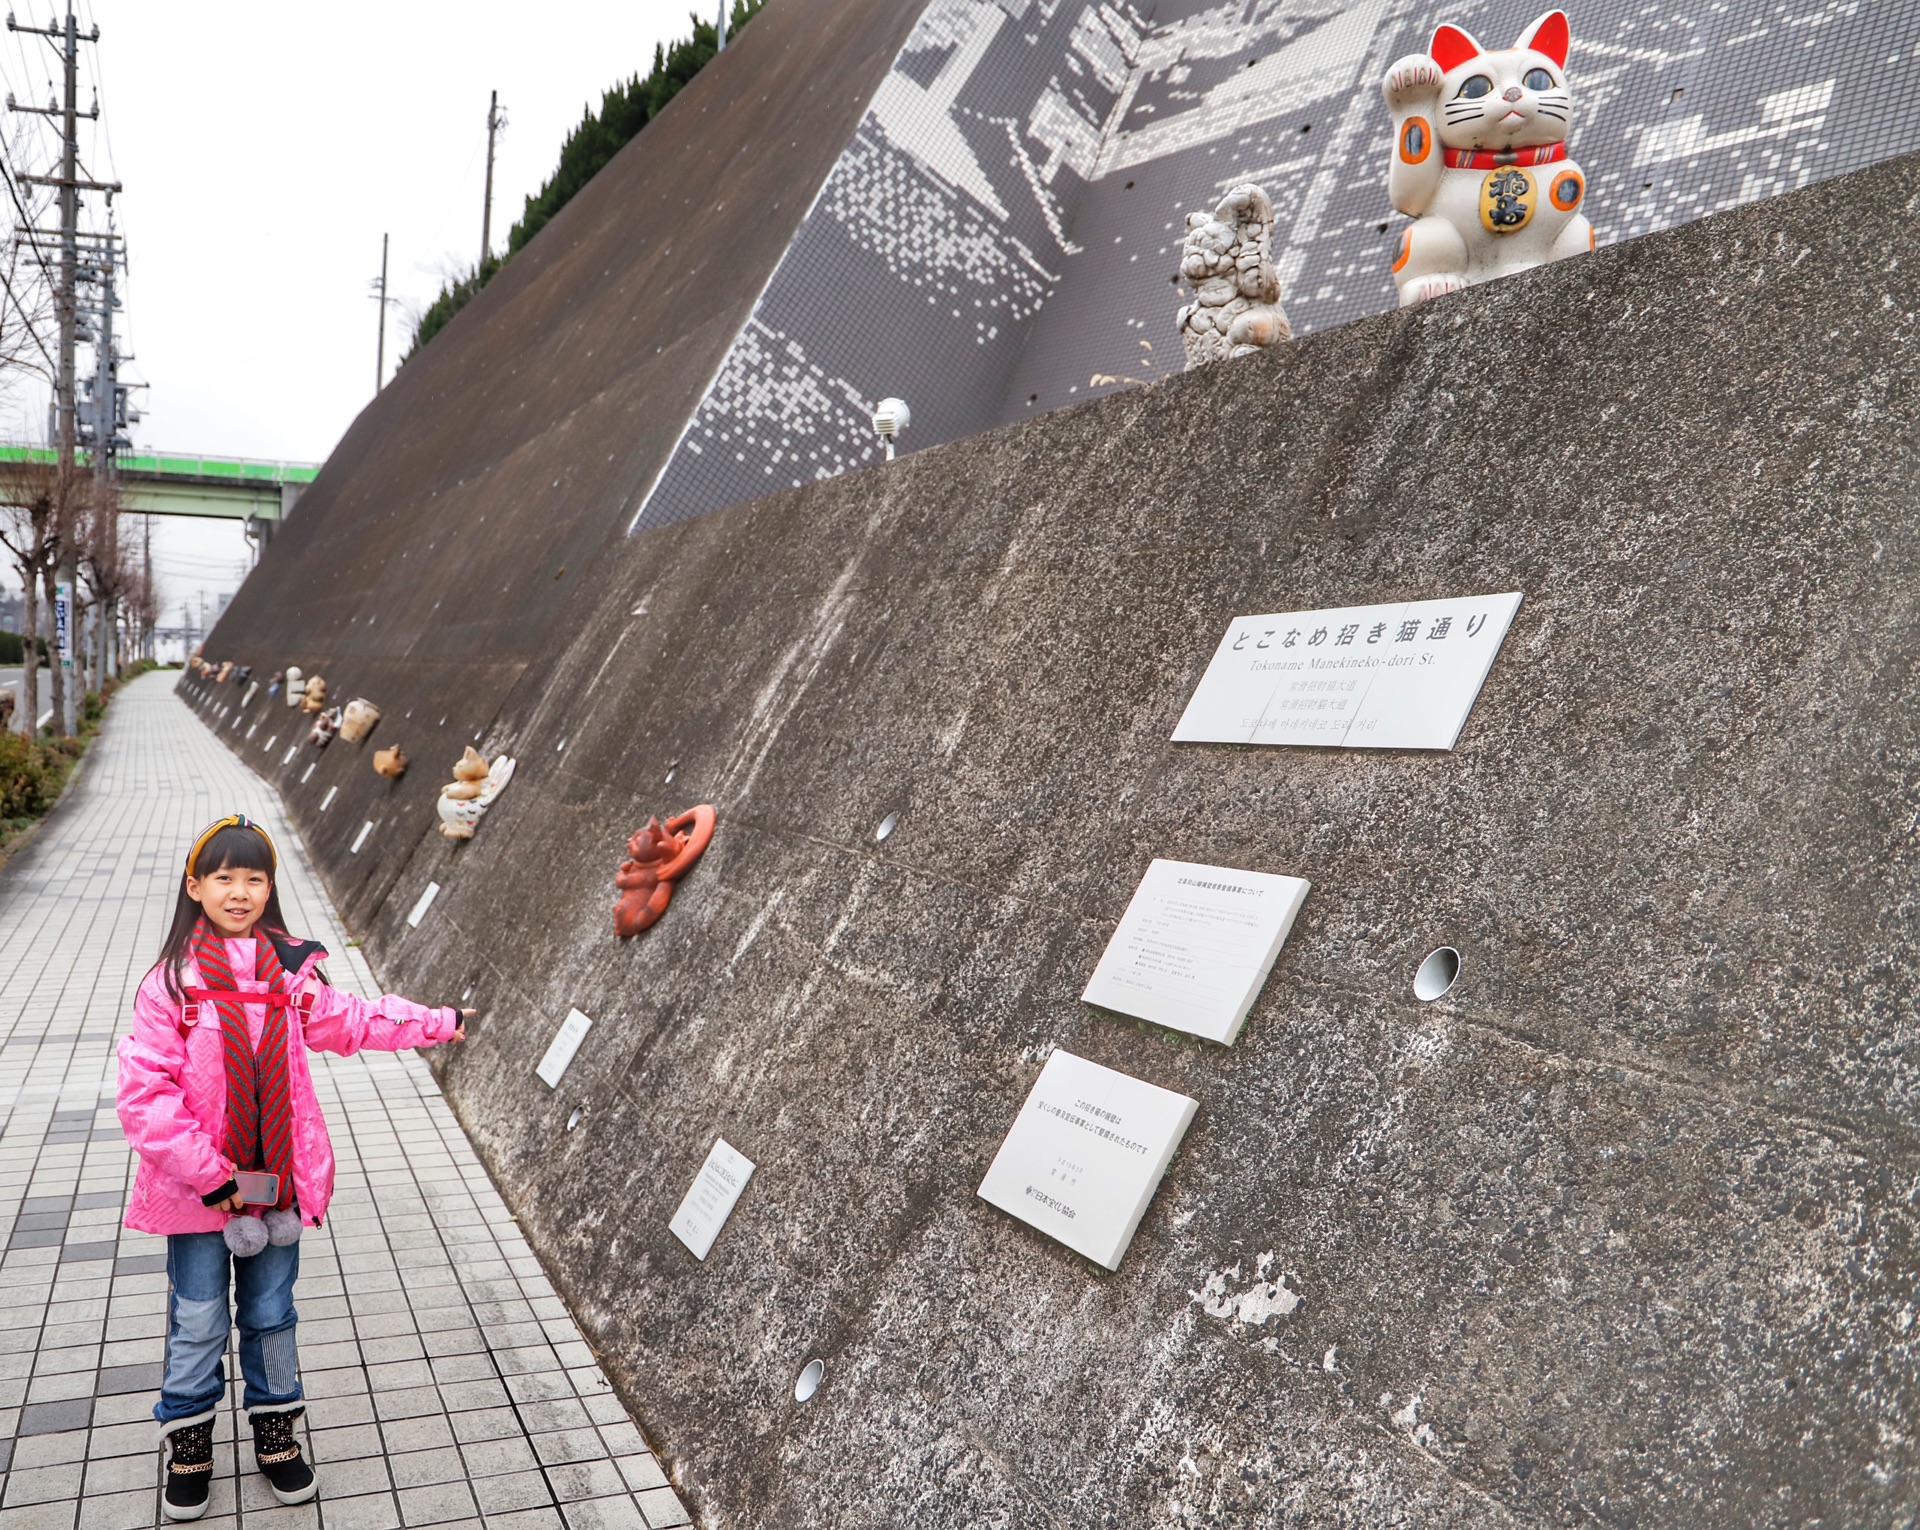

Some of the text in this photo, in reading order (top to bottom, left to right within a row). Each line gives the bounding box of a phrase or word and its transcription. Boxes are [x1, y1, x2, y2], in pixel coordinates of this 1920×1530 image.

[1232, 614, 1488, 651] とこなめ招き猫通り
[1249, 653, 1437, 671] Tokoname Manekineko-dori St.
[1356, 719, 1378, 731] 거리
[1036, 1100, 1149, 1155] 宝くじの普及宣伝事業として整備されたものです
